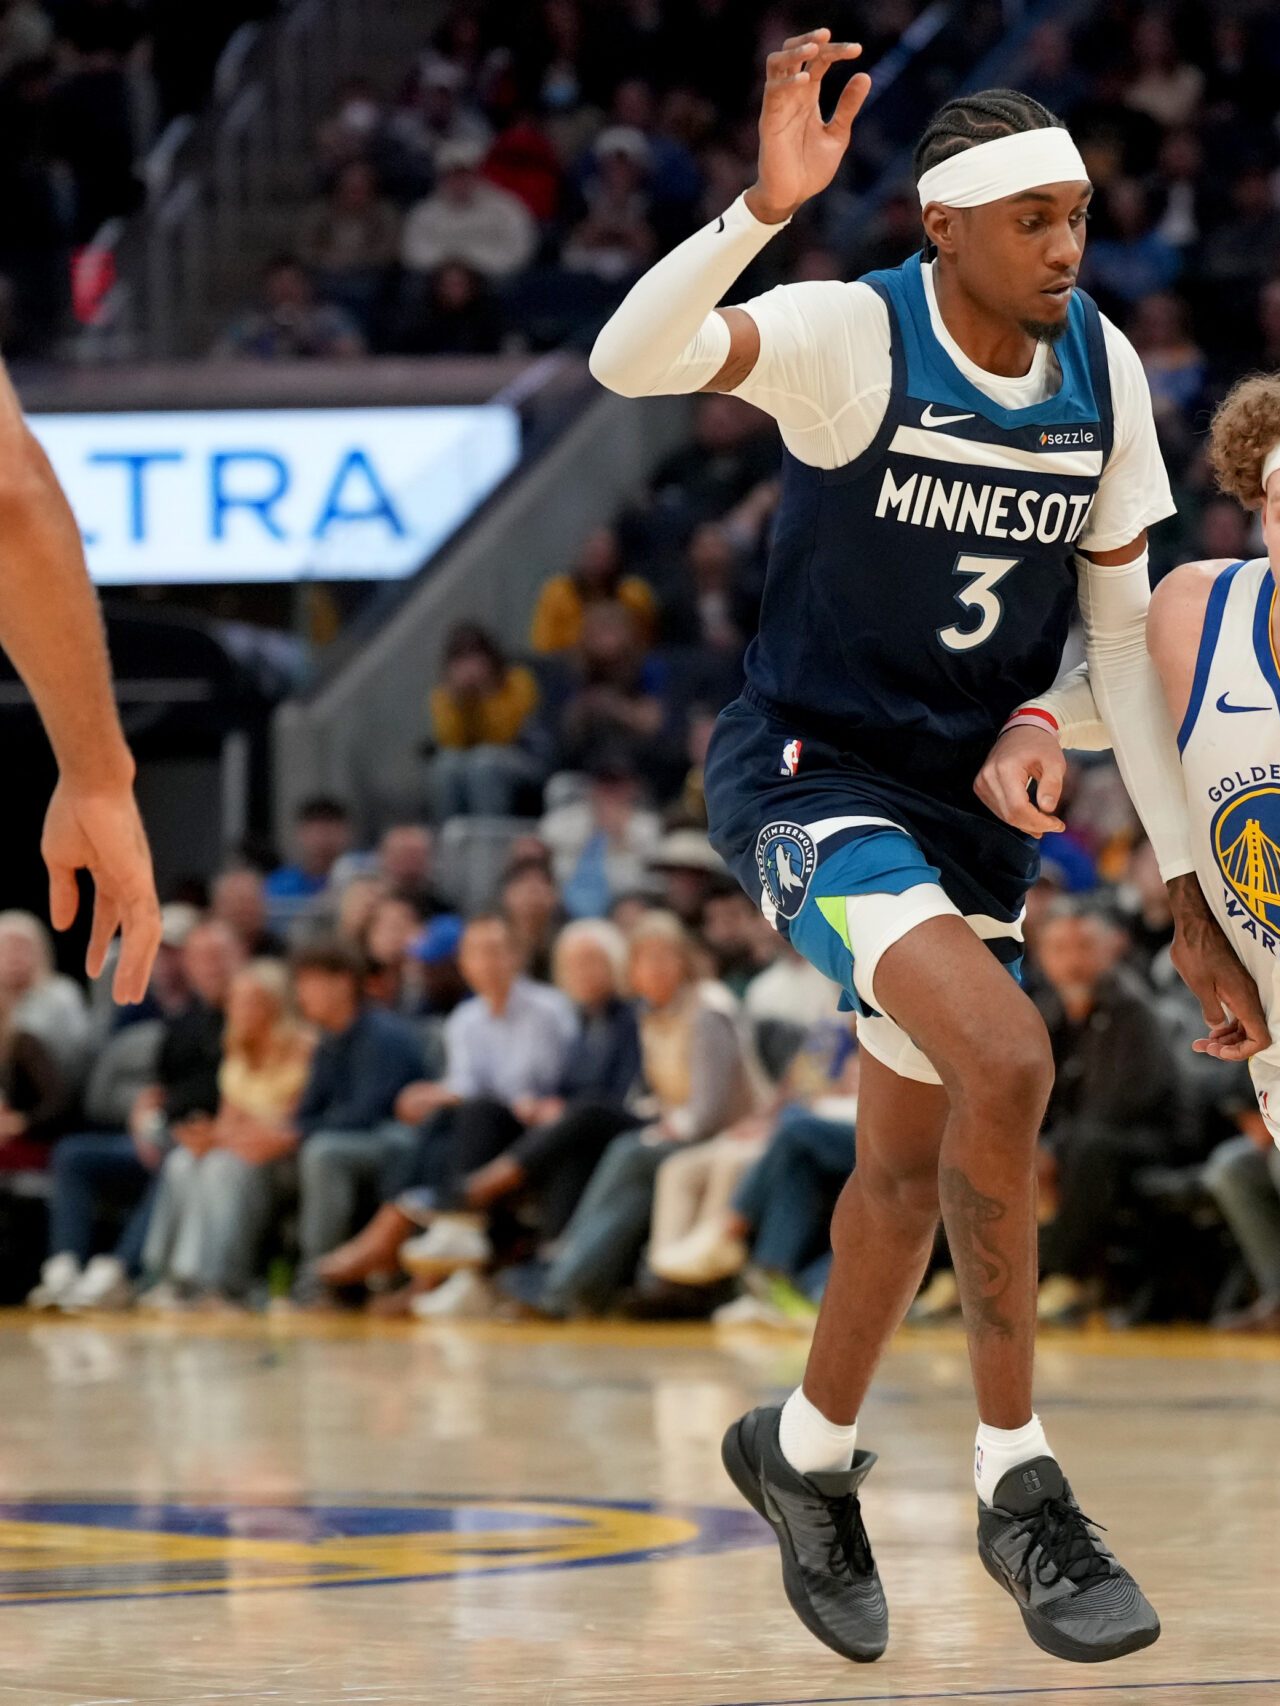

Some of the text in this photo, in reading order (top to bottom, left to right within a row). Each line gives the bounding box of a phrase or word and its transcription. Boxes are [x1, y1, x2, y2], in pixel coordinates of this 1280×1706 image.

[1047, 428, 1094, 445] sezzle
[83, 446, 407, 546] TRA
[935, 551, 1025, 654] 3
[762, 825, 814, 873] TIMBERWOLVES
